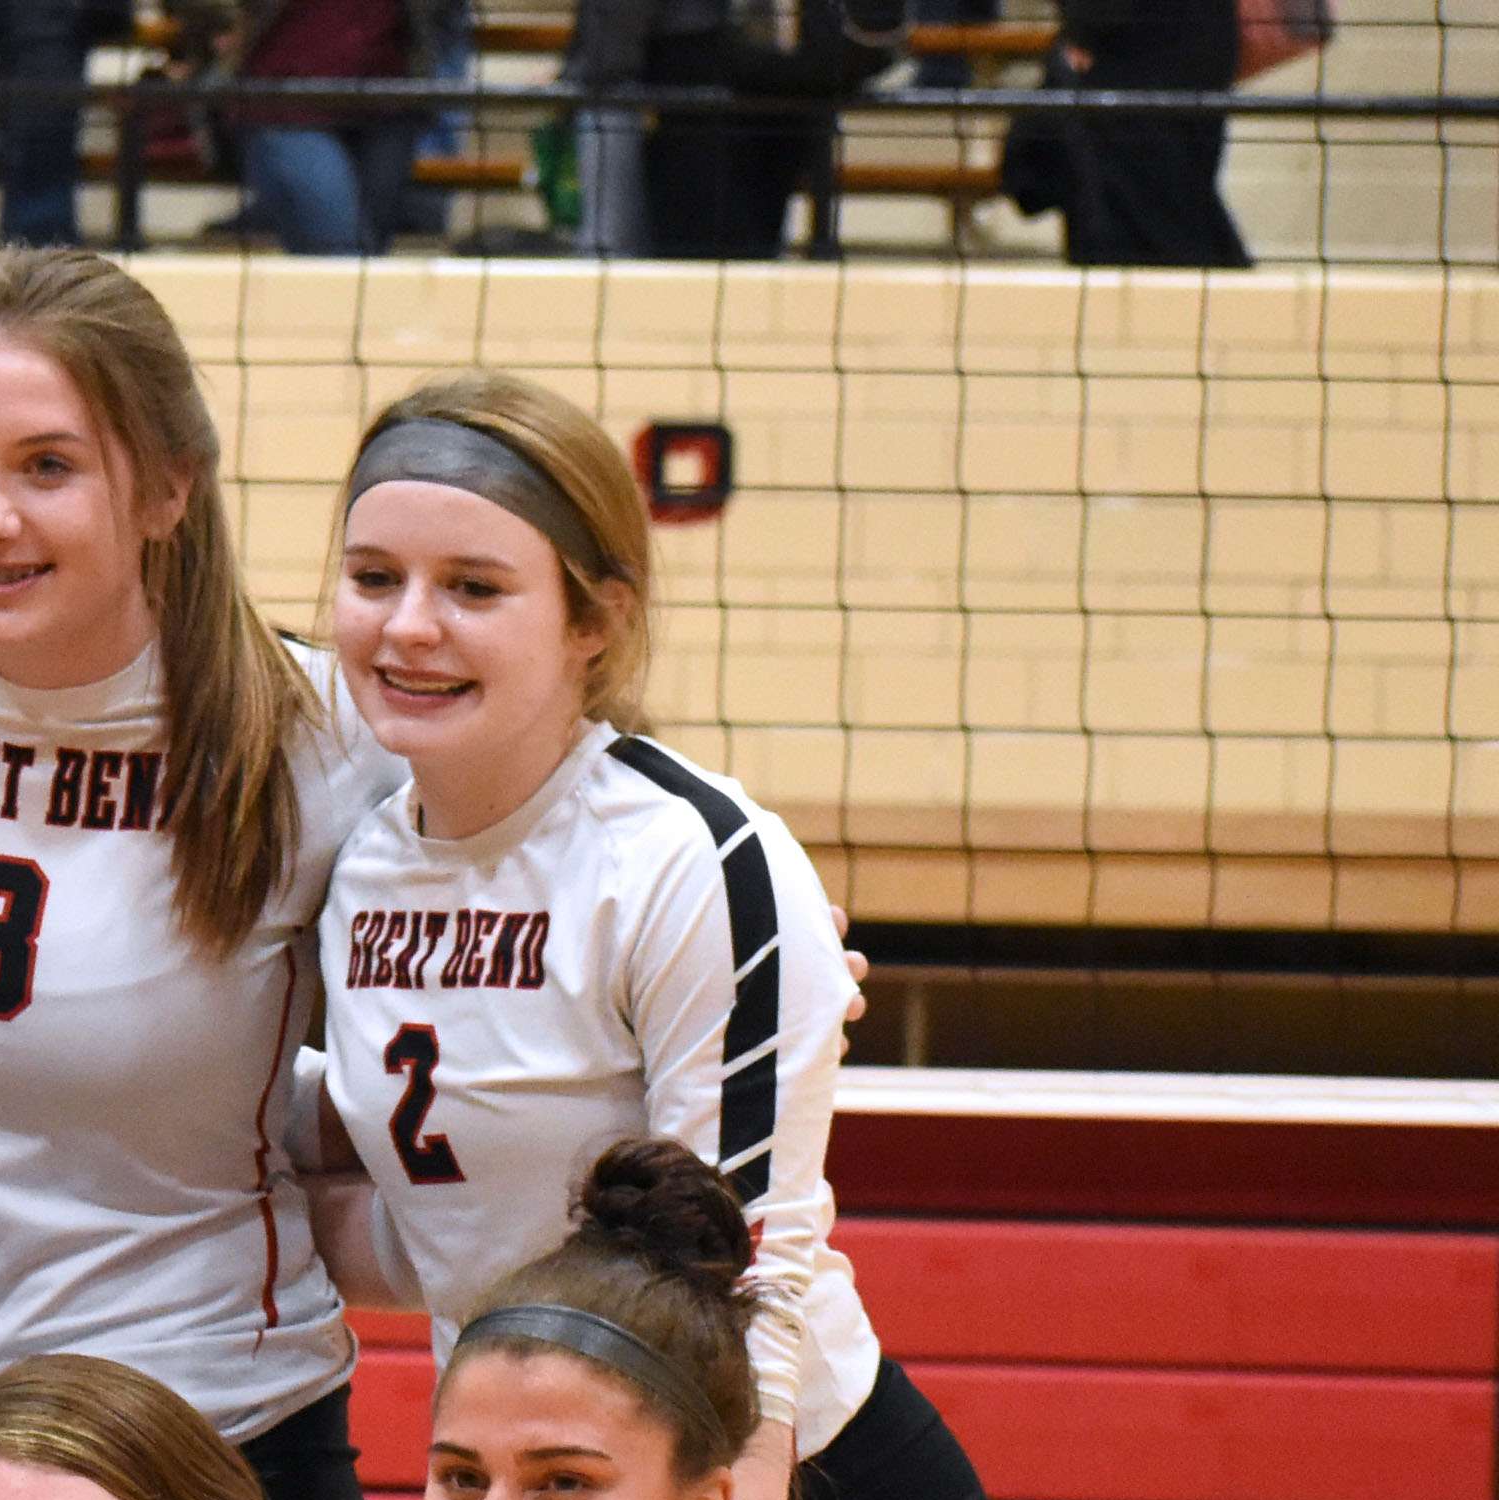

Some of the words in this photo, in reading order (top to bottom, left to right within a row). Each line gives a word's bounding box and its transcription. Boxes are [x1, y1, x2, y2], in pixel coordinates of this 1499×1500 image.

[346, 910, 449, 990] GREAT
[440, 908, 550, 990] BEND
[383, 1022, 467, 1185] 2
